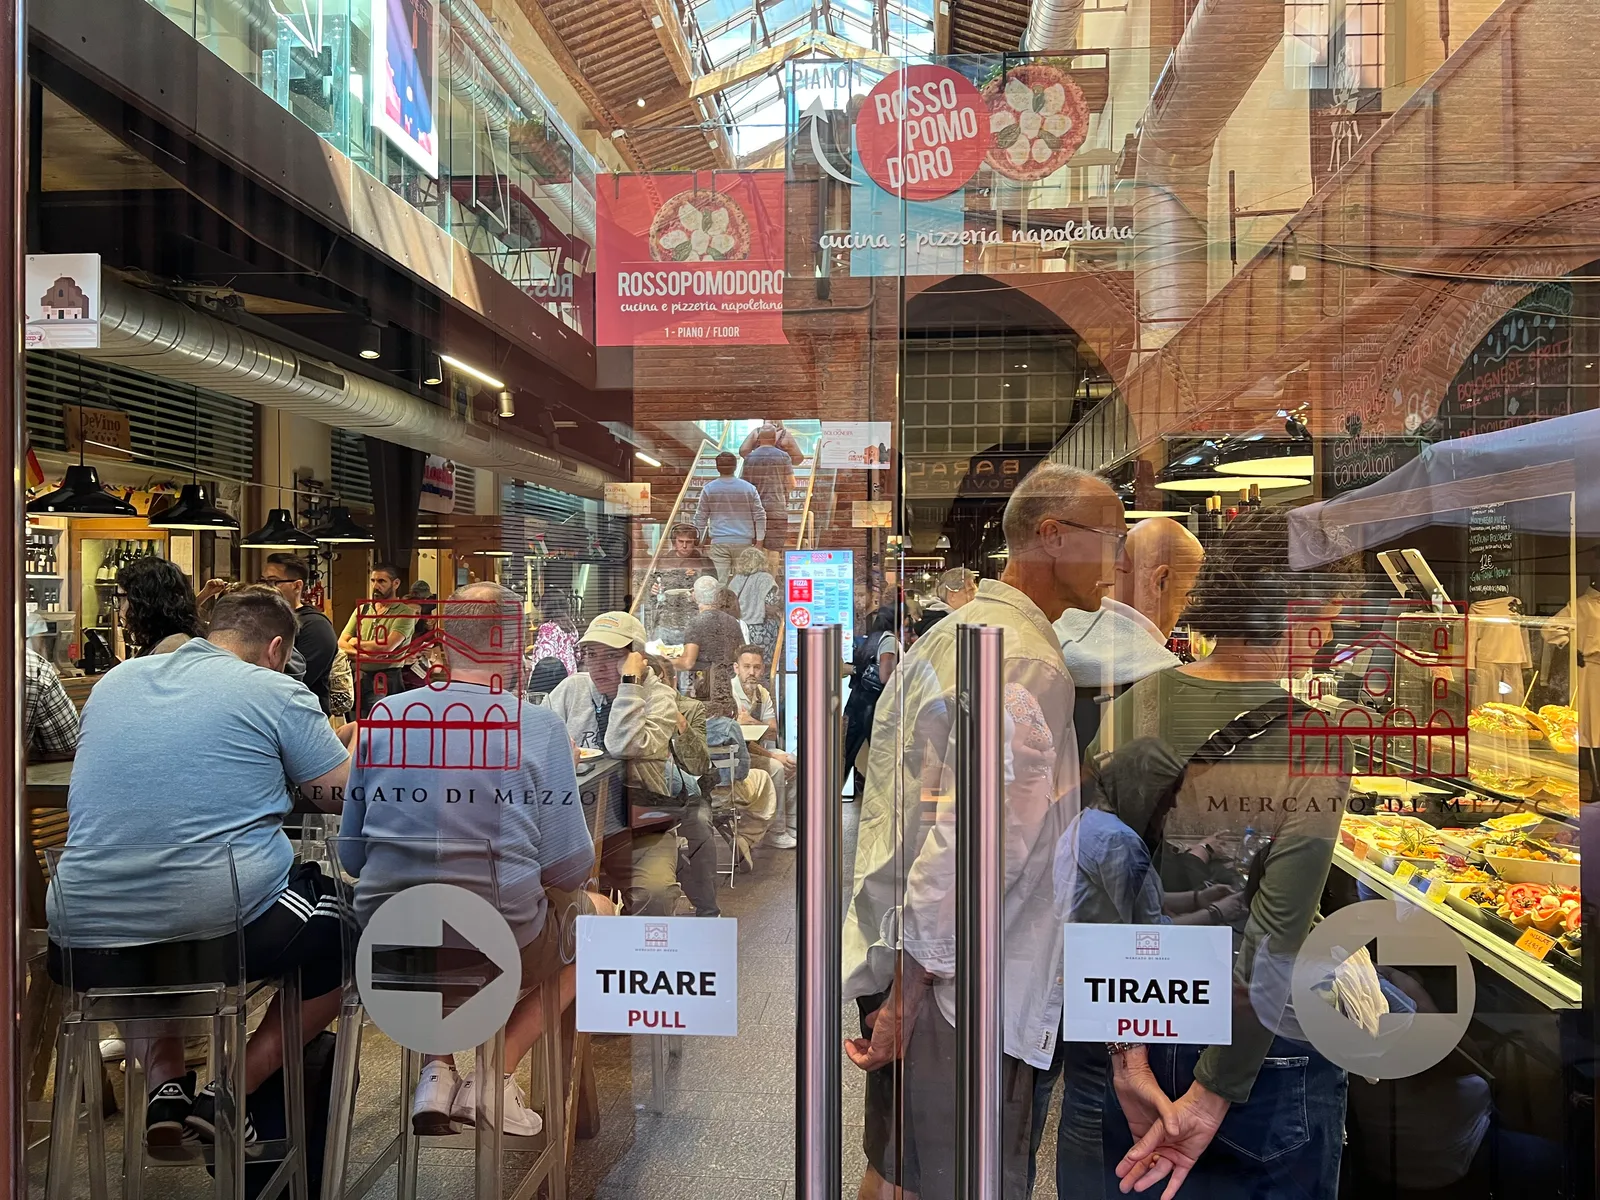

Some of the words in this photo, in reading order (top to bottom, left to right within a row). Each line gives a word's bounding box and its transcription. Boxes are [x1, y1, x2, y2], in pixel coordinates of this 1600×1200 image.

[793, 66, 849, 90] PIANO
[875, 78, 957, 125] ROSSO
[906, 107, 978, 151] POMO
[886, 145, 953, 189] DORO
[819, 231, 890, 249] cucina
[916, 227, 1004, 252] pizzeria
[1012, 219, 1134, 248] napoletana
[618, 270, 784, 297] ROSSOPOMODORO
[620, 302, 658, 312] cucina
[671, 302, 717, 314] pizzeria
[721, 299, 783, 313] napoletana
[678, 327, 704, 338] PIANO
[713, 327, 740, 338] FLOOR
[284, 785, 428, 803] MERCATO
[446, 788, 474, 804] DI
[494, 788, 596, 806] MEZZO
[1207, 795, 1367, 814] MERCATO
[1387, 795, 1419, 814] DI
[596, 969, 716, 996] TIRARE
[1084, 977, 1210, 1004] TIRARE
[628, 1010, 686, 1028] PULL
[1117, 1018, 1178, 1037] PULL
